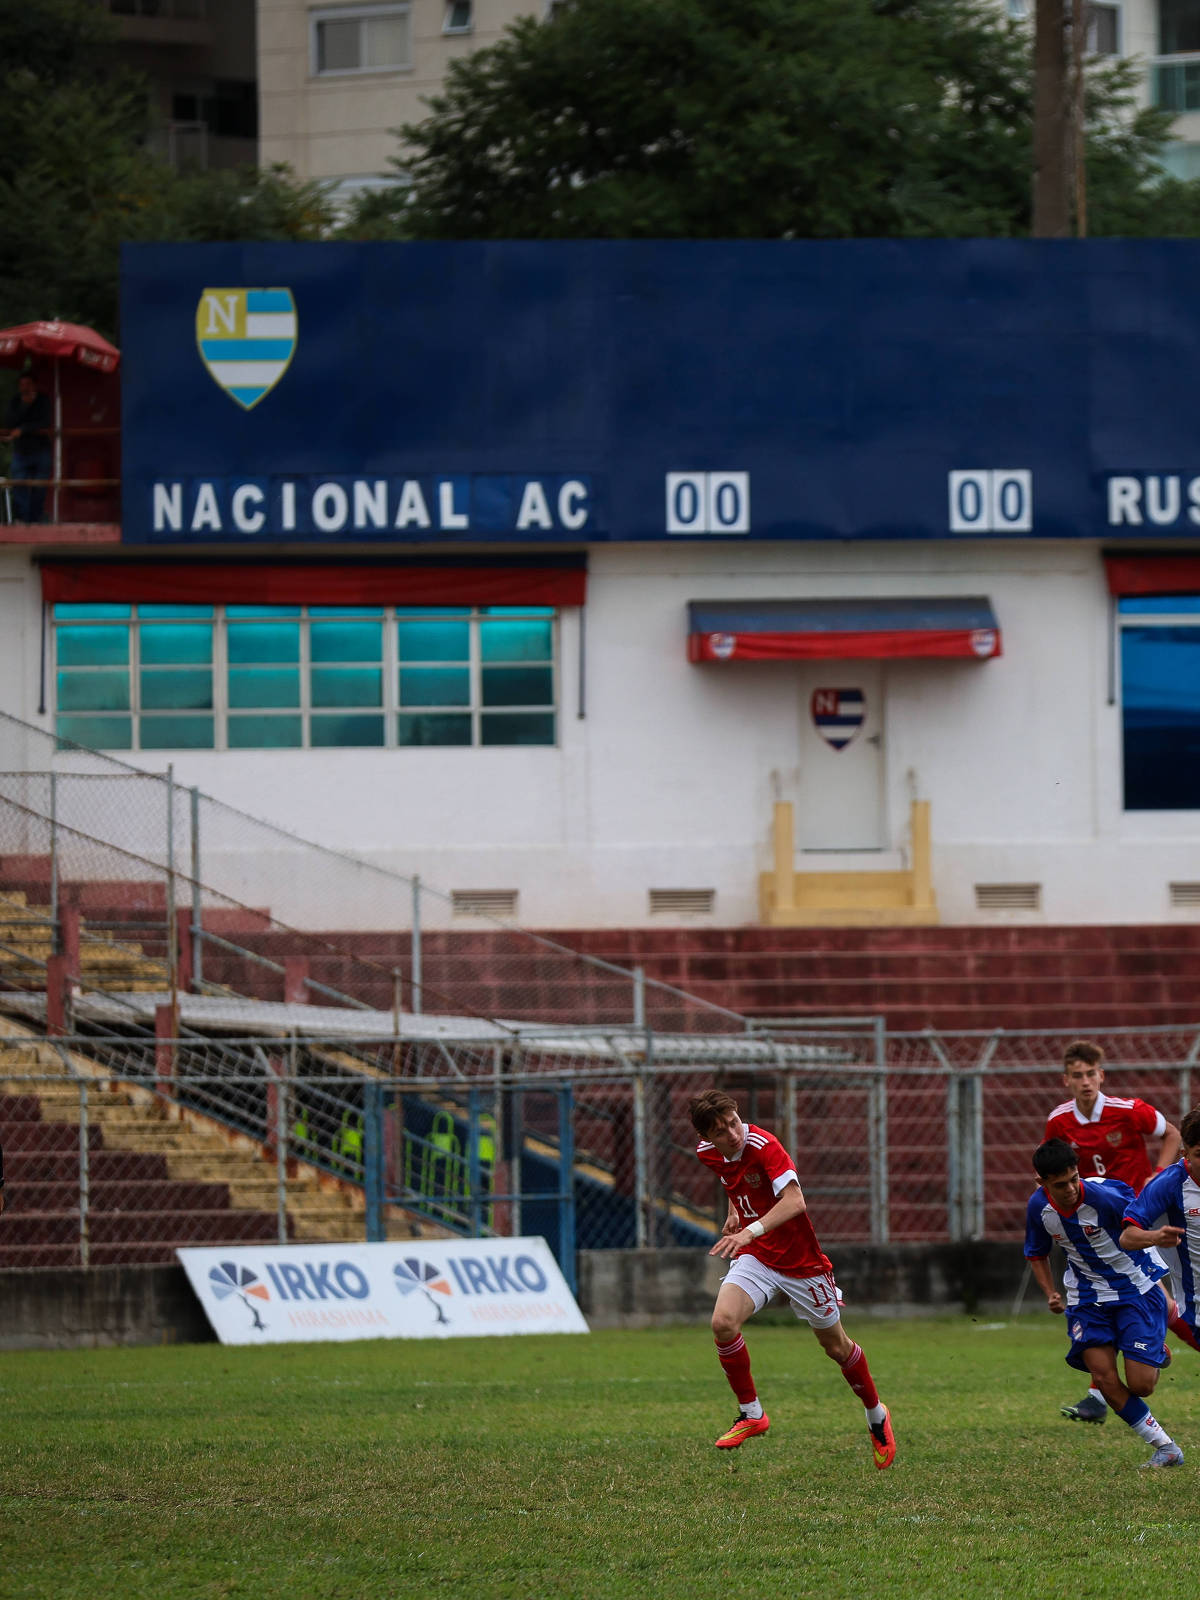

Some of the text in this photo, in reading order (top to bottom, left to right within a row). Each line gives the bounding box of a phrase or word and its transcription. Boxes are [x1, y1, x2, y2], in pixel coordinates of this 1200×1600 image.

[205, 295, 238, 334] N
[152, 480, 588, 532] NACIONAL AC
[672, 478, 744, 529] 00
[954, 475, 1026, 527] 00
[815, 692, 836, 714] N
[1092, 1153, 1106, 1176] 6
[737, 1194, 759, 1219] 11
[265, 1261, 371, 1300] IRKO
[447, 1254, 549, 1296] IRKO
[806, 1283, 833, 1308] 11
